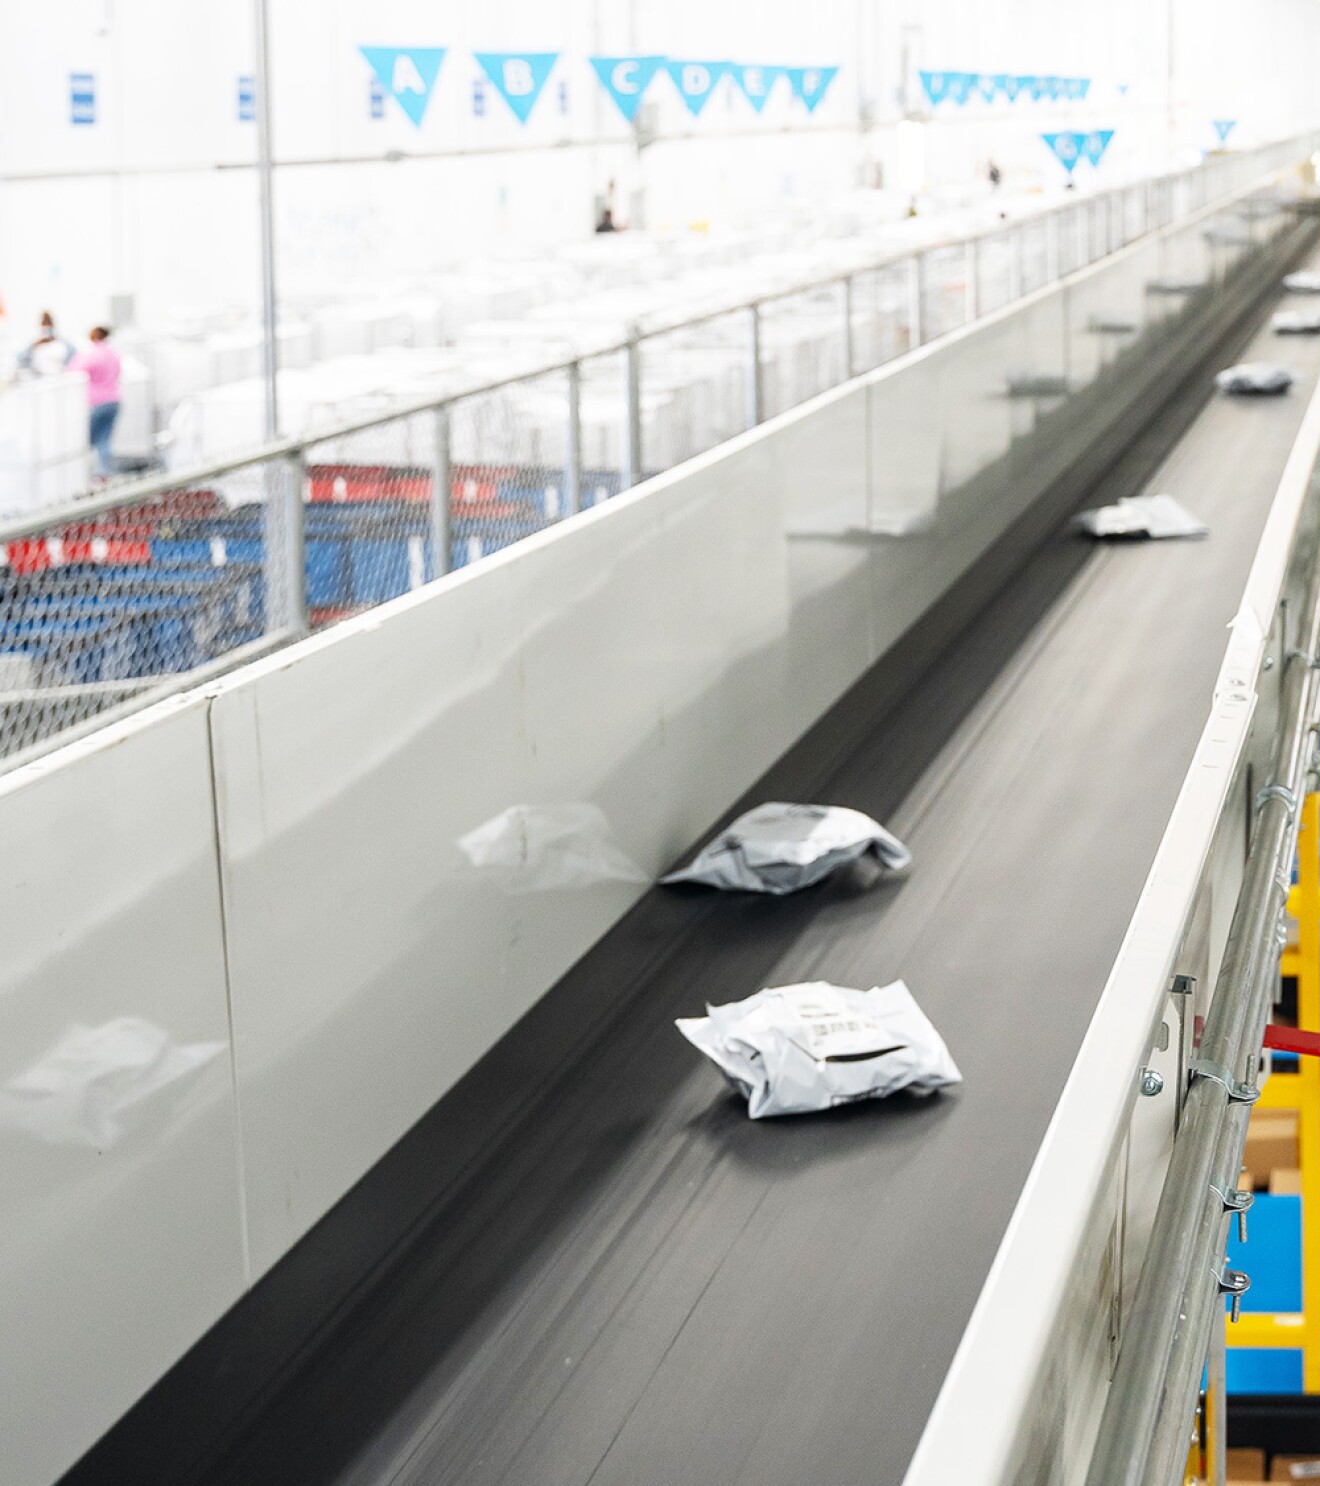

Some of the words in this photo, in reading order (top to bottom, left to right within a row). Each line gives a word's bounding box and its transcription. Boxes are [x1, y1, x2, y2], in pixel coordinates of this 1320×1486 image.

[391, 53, 427, 96] A
[502, 57, 536, 96] B
[611, 60, 641, 96] C
[681, 64, 712, 96] D
[743, 67, 768, 97] E
